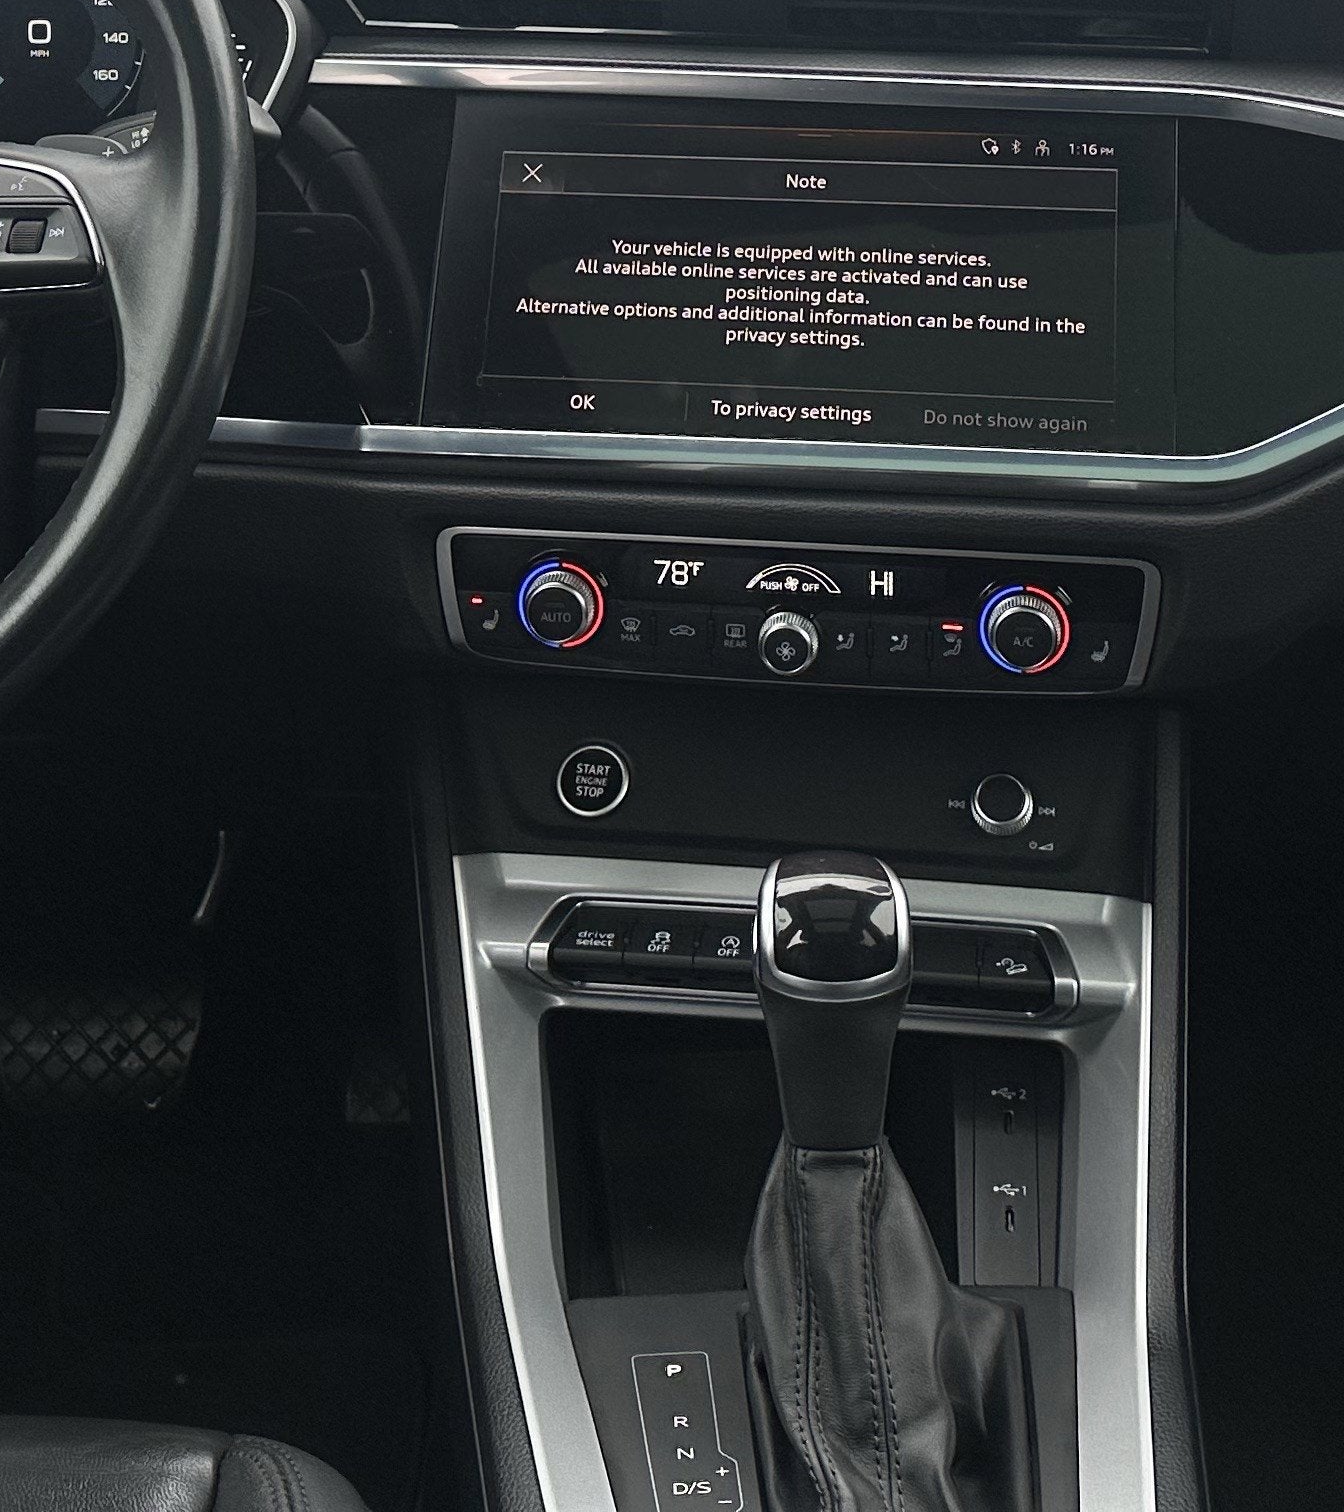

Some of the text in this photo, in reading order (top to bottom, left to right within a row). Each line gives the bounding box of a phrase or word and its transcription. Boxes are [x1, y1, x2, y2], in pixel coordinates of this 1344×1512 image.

[27, 19, 52, 44] 0
[103, 32, 129, 44] 140
[30, 49, 50, 58] MPH
[92, 70, 119, 81] 160
[1068, 144, 1114, 156] 1:16 PM
[786, 173, 827, 189] Note
[612, 240, 992, 267] Your vehicle is equipped with online services.
[575, 259, 1028, 288] All available online services are activated and can use
[725, 287, 870, 306] positioning data.
[516, 298, 1086, 334] Alternative options and additional information can be found in the
[725, 327, 865, 349] privacy settings.
[569, 394, 596, 411] OK
[711, 400, 872, 425] To privacy settings
[923, 409, 1088, 433] Do not show again
[760, 581, 820, 593] PUSH OFF
[870, 570, 894, 596] HI
[540, 612, 571, 623] AUTO
[620, 634, 641, 643] MAX
[723, 638, 747, 649] REAR
[1012, 636, 1035, 648] A/C
[576, 763, 611, 776] START
[575, 776, 607, 786] ENGINE
[576, 787, 604, 798] STOP
[578, 930, 615, 939] drive
[576, 938, 614, 947] select
[647, 944, 671, 953] OFF
[717, 948, 740, 957] OFF
[1019, 1089, 1027, 1100] 2
[1022, 1186, 1027, 1196] 1
[665, 1364, 682, 1377] P
[673, 1416, 689, 1428] R
[676, 1448, 694, 1459] N
[672, 1481, 712, 1496] D/S
